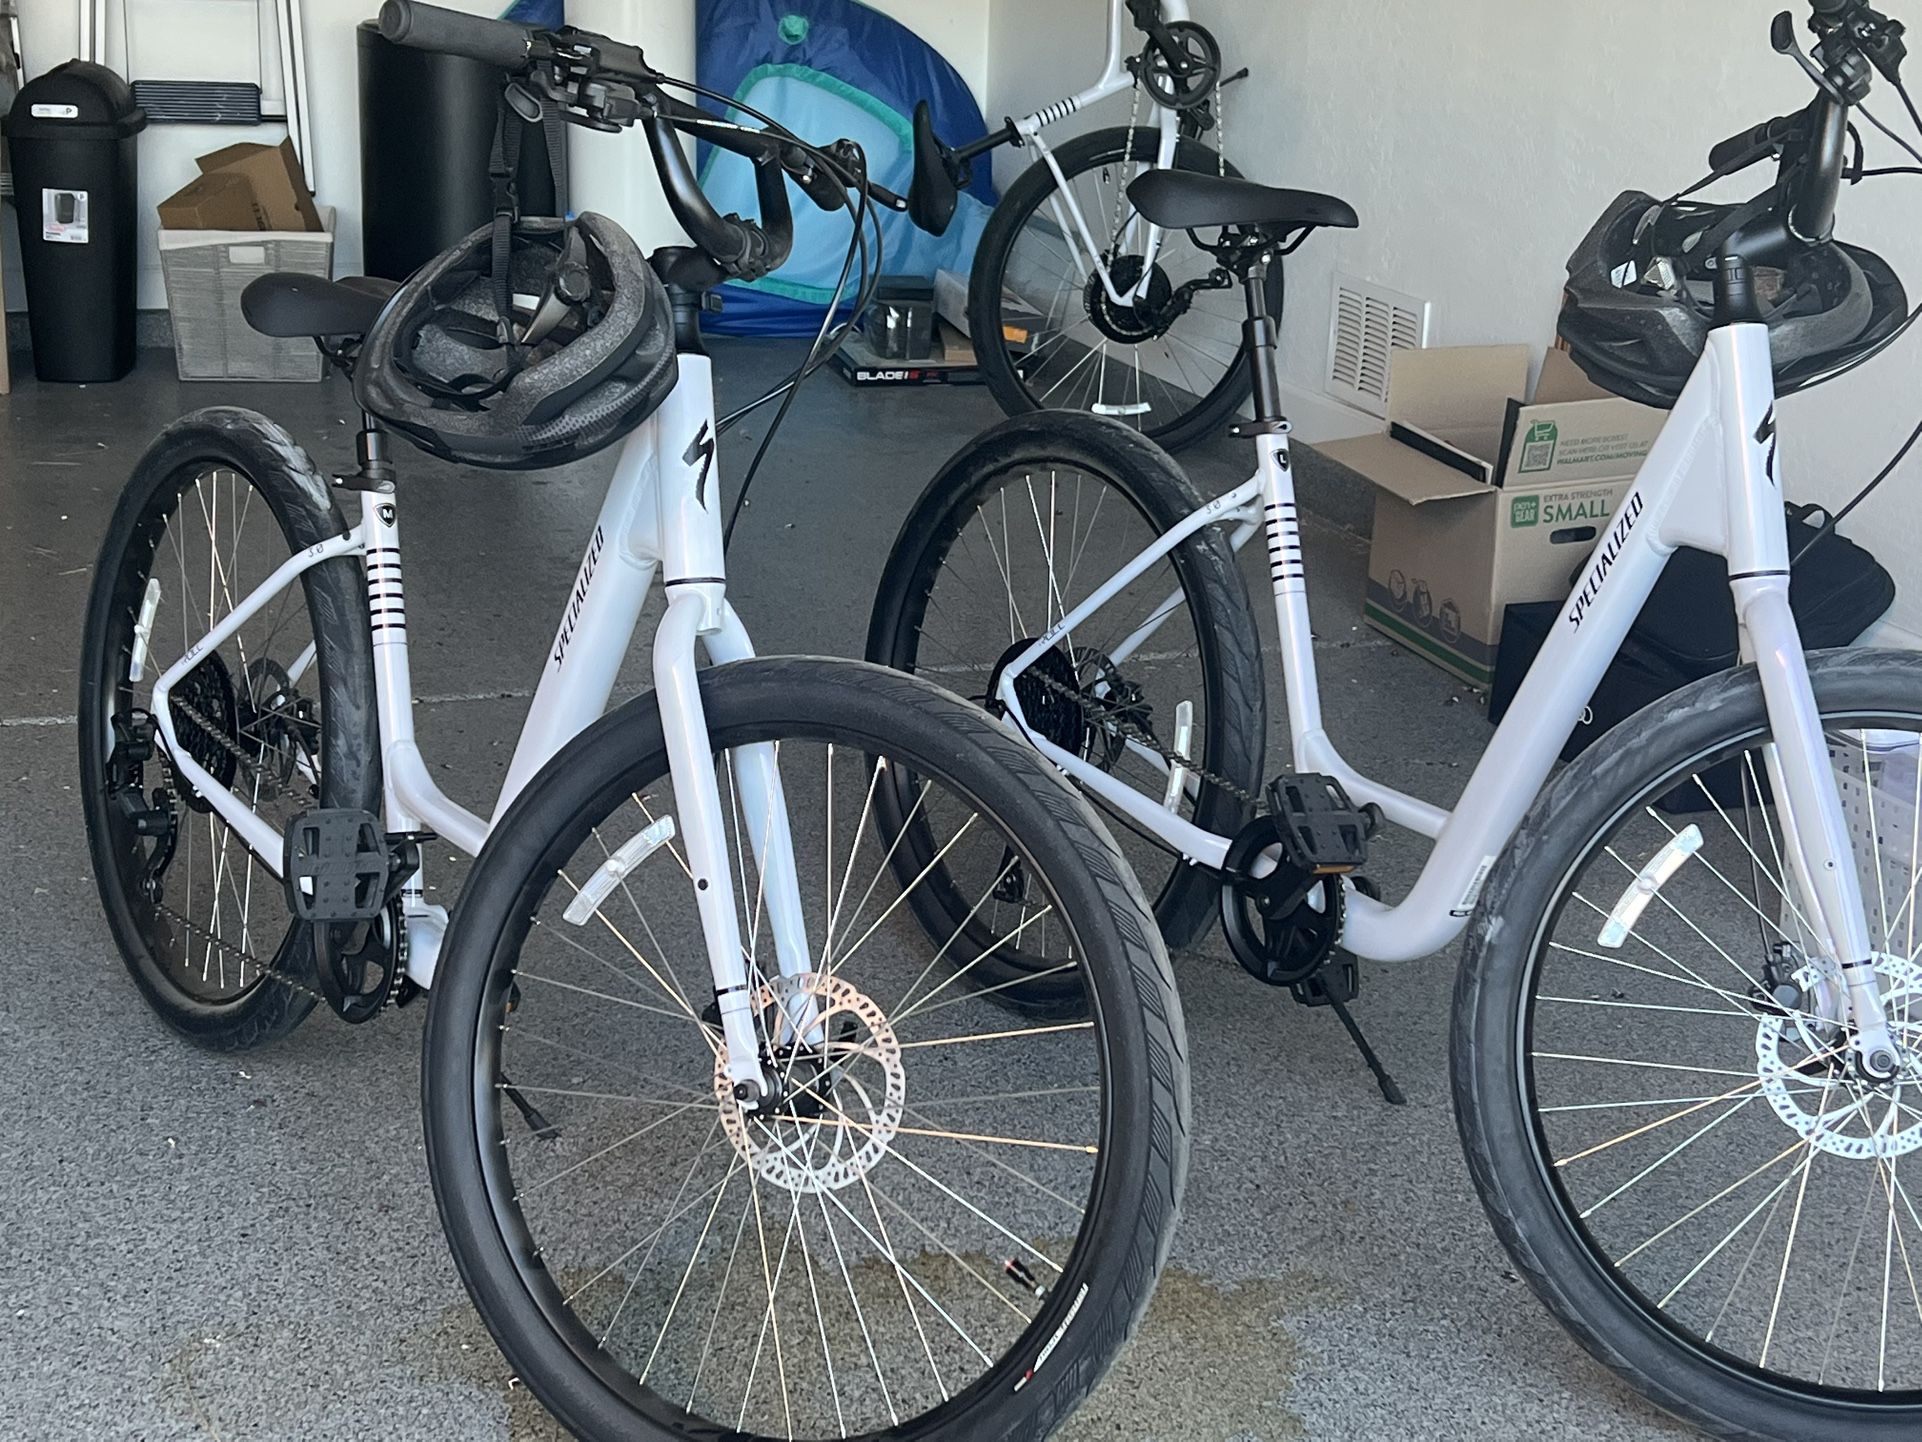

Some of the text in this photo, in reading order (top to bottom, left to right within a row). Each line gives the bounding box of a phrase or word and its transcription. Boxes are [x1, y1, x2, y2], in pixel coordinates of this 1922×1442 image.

[1543, 488, 1613, 503] EXTRA STRENGTH
[382, 508, 393, 518] M
[1543, 499, 1611, 523] SMALL
[1568, 491, 1644, 634] SPECIALIZED
[554, 525, 604, 673] SPECIALIZED
